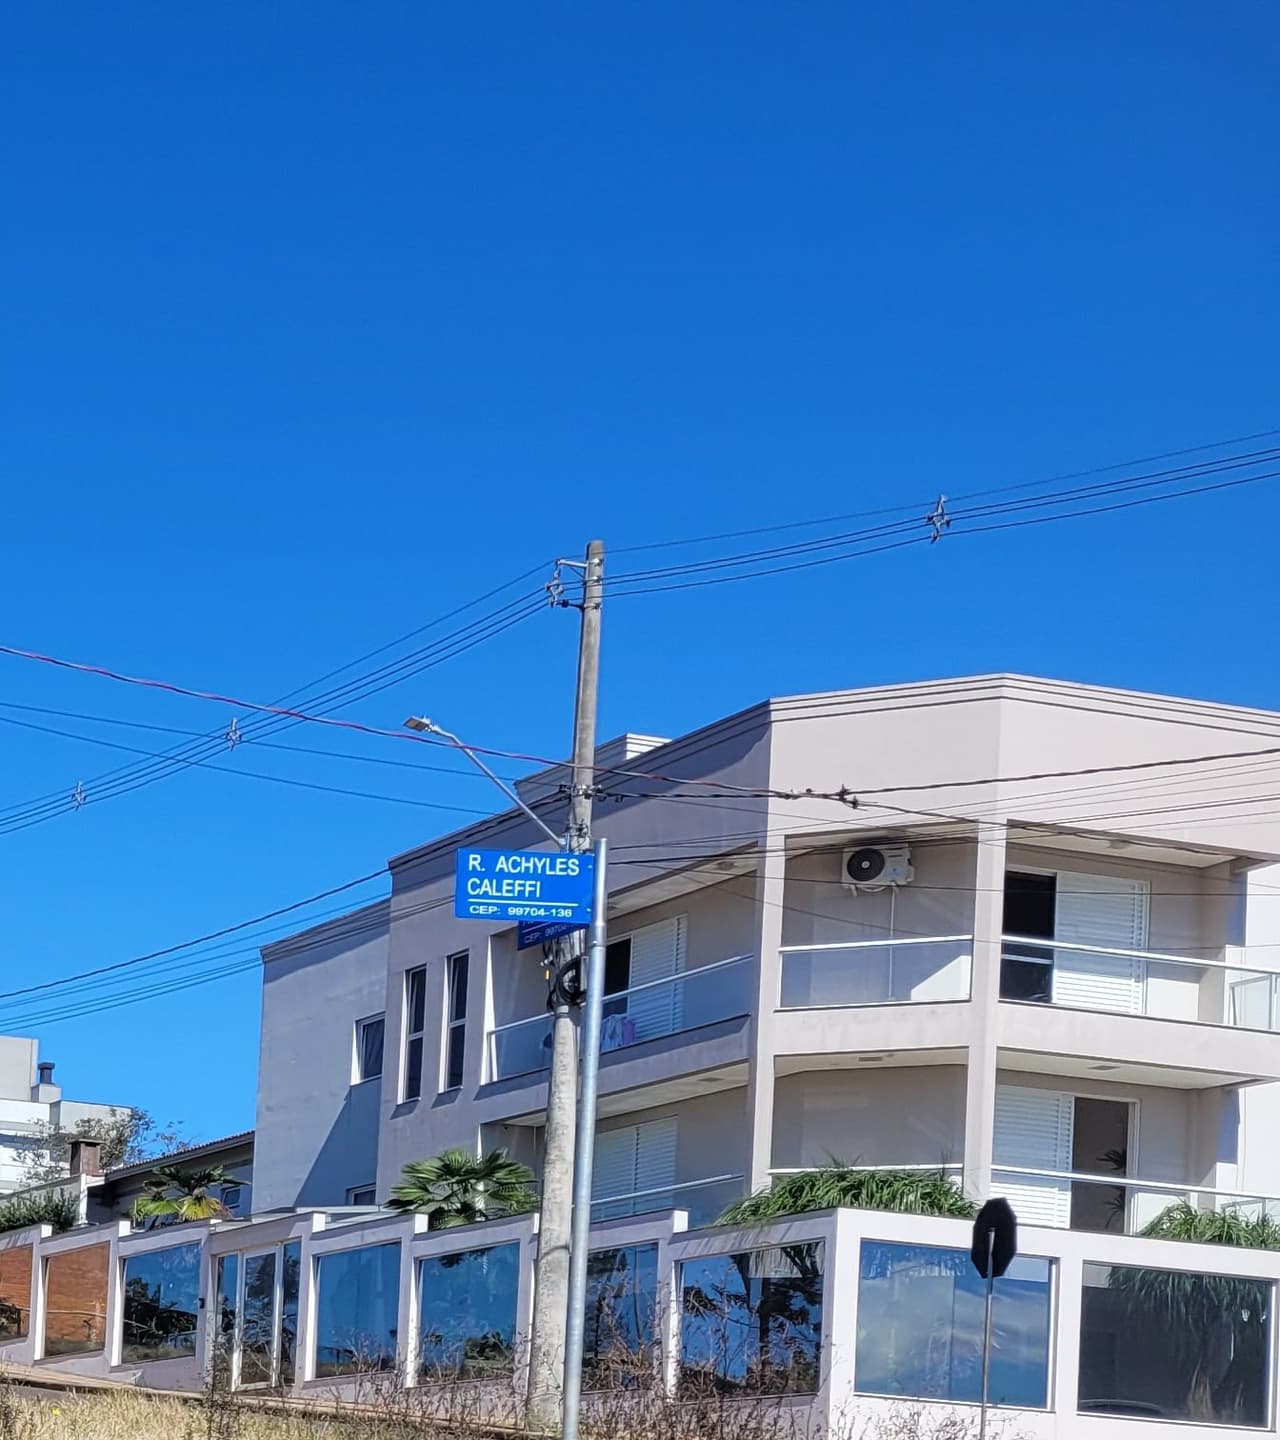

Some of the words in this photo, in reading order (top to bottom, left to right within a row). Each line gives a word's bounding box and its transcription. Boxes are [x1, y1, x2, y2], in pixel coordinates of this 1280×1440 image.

[468, 854, 486, 872] R.
[495, 855, 579, 875] ACHYLES
[467, 878, 540, 897] CALEFFI
[469, 905, 501, 915] CEP:
[507, 907, 572, 917] 99704-136
